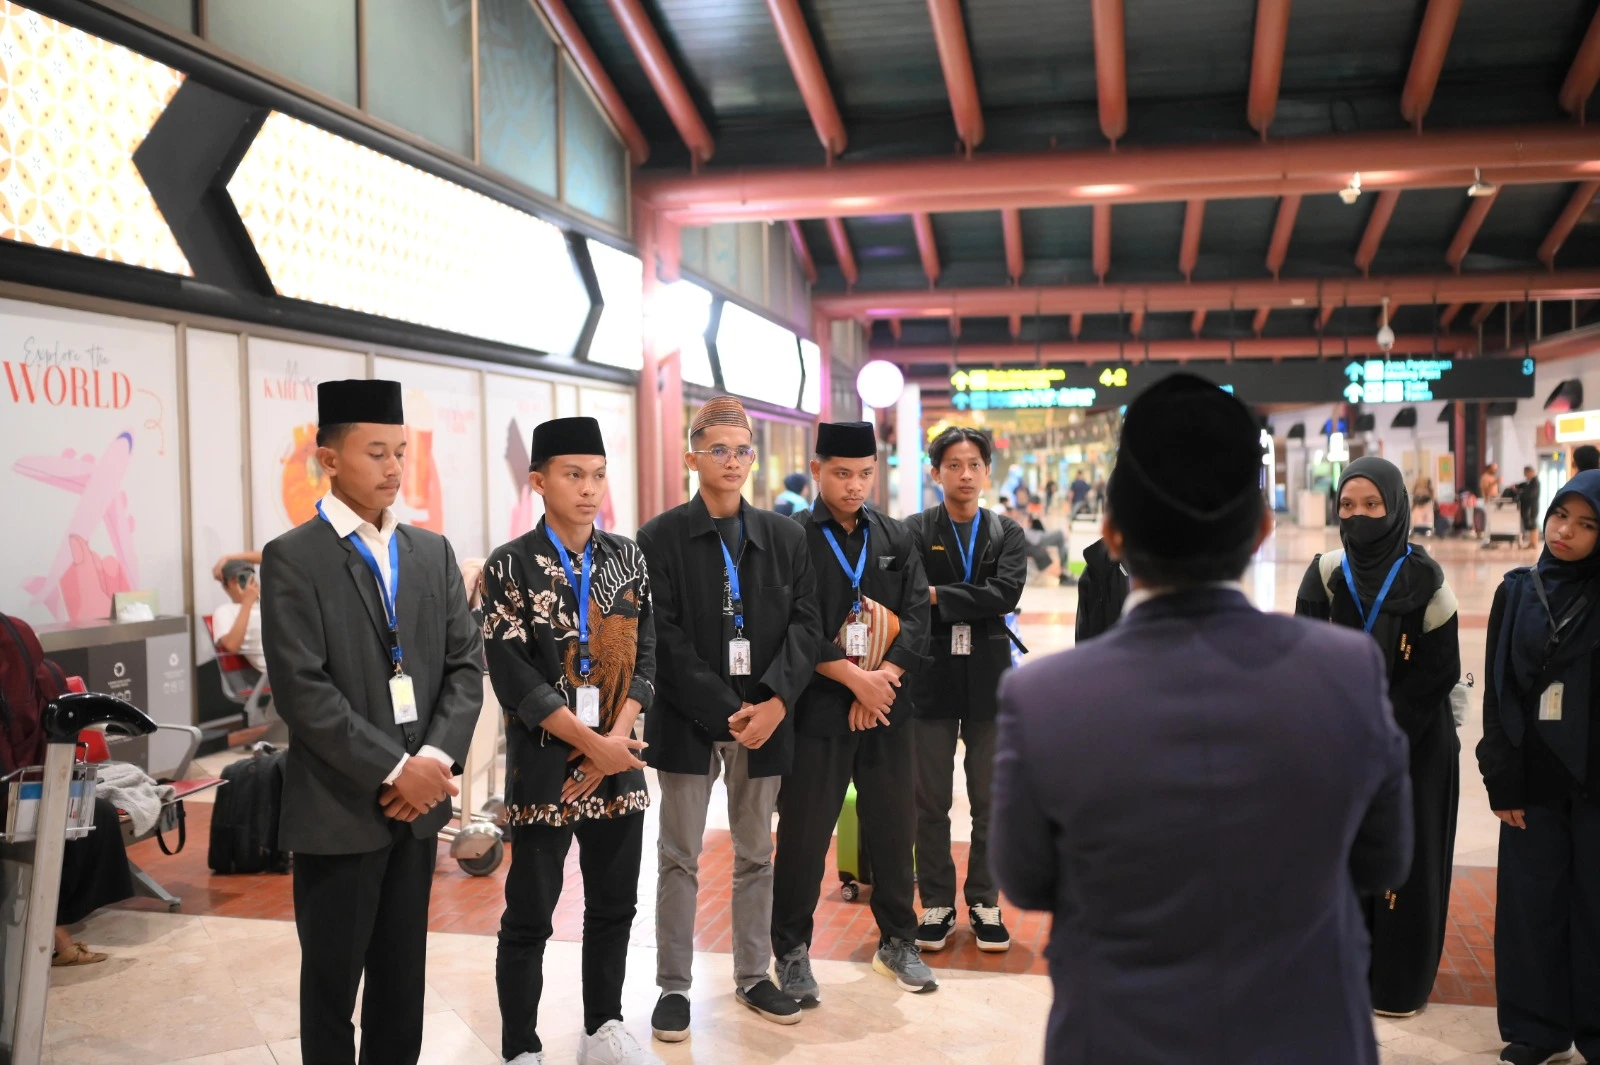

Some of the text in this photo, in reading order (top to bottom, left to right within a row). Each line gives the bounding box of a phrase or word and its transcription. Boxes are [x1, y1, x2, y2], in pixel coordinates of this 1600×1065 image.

[24, 336, 81, 368] Explore
[1522, 358, 1534, 375] 3
[3, 361, 132, 410] WORLD
